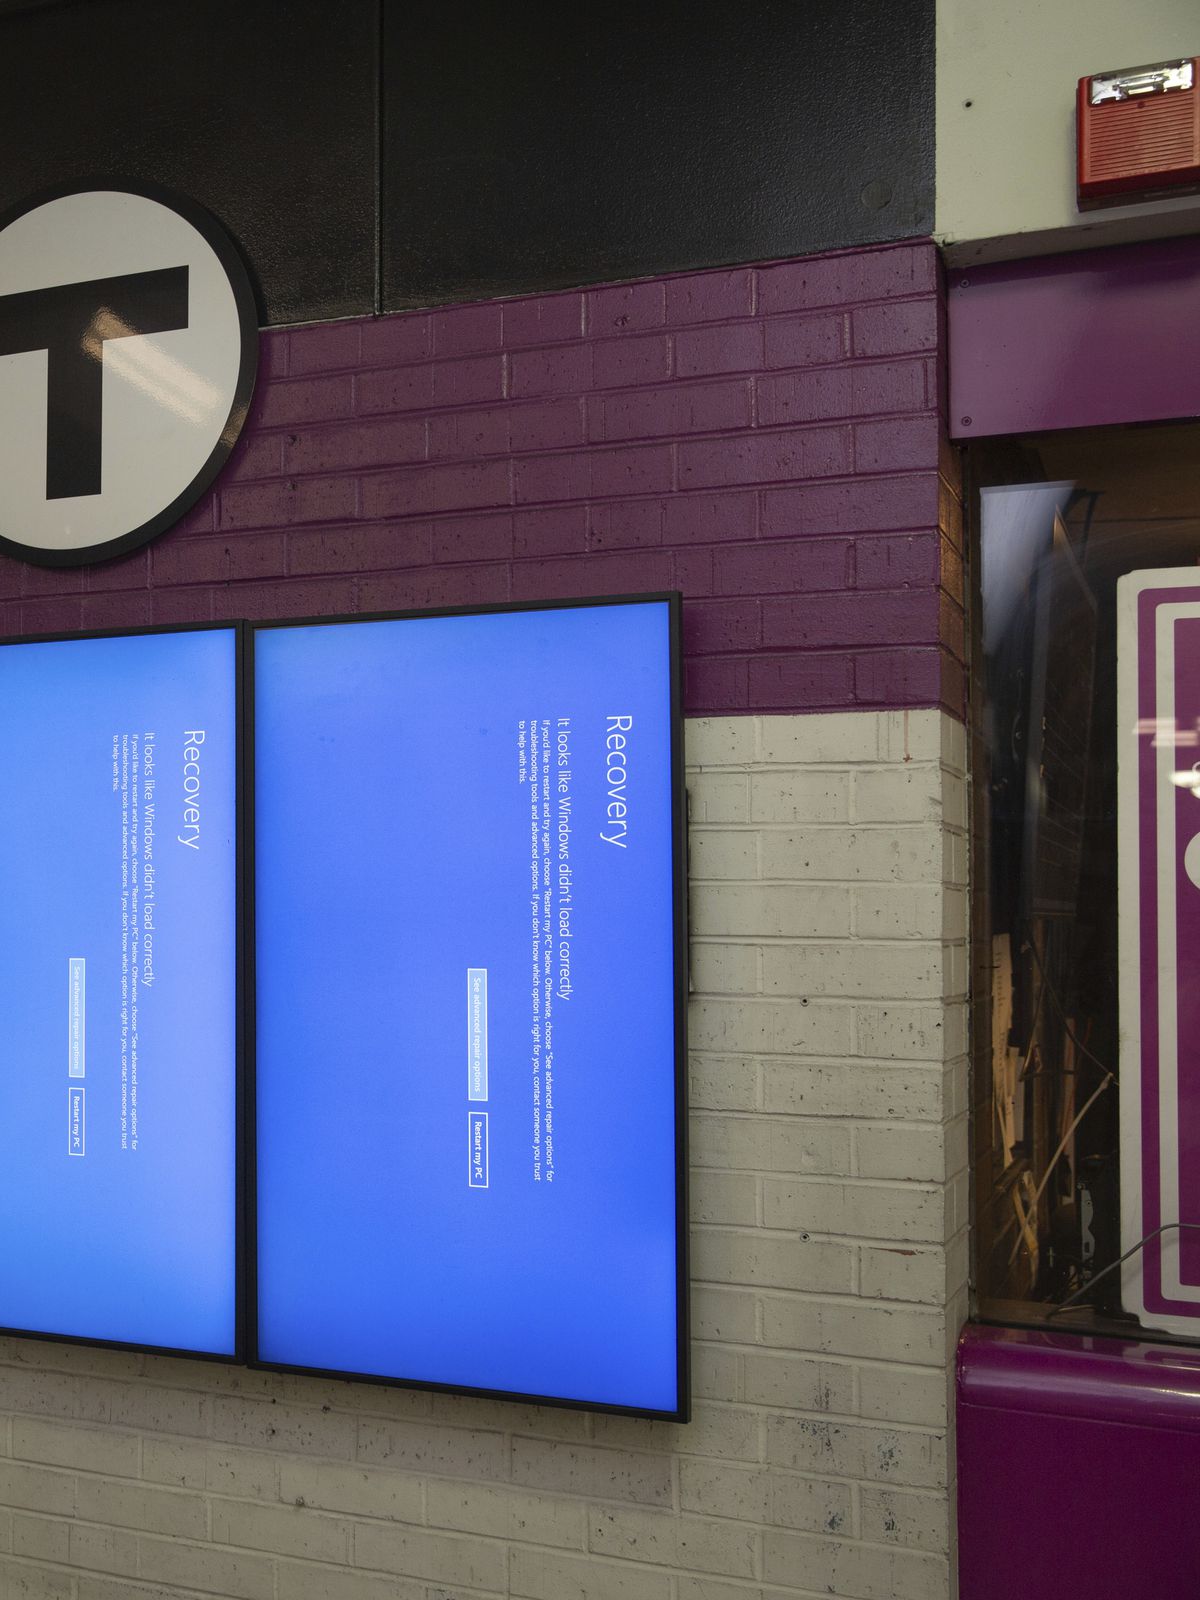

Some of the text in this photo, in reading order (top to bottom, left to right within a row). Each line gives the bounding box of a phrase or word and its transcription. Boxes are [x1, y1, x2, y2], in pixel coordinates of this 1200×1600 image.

[113, 735, 119, 743] to
[541, 727, 551, 748] you'd
[130, 740, 139, 760] you'd
[517, 721, 527, 784] to help with this.
[529, 720, 539, 782] troubleshooting
[542, 750, 551, 763] like
[120, 735, 129, 790] troubleshooting
[131, 761, 139, 773] like
[542, 765, 551, 774] to
[131, 775, 139, 783] to
[542, 775, 551, 801] restart
[600, 715, 632, 848] Recovery
[121, 791, 129, 809] tools
[131, 784, 139, 807] restart
[178, 730, 205, 850] Recovery
[530, 783, 539, 803] tools
[121, 810, 129, 824] and
[131, 809, 139, 822] and
[530, 804, 539, 819] and
[543, 802, 551, 817] and
[130, 823, 138, 834] try
[542, 819, 551, 830] try
[121, 825, 129, 859] advanced
[130, 835, 138, 857] again,
[531, 821, 540, 859] advanced
[542, 832, 552, 856] again,
[141, 733, 156, 987] It looks like Windows didn't load correctly
[556, 718, 573, 1000] It looks like Windows didn't load correctly
[120, 861, 129, 889] options.
[131, 858, 139, 884] choose
[530, 860, 540, 892] options.
[544, 857, 552, 886] choose
[131, 885, 139, 913] "Restart
[530, 901, 539, 916] you
[544, 888, 553, 918] "Restart
[121, 912, 129, 931] don't
[130, 914, 137, 926] my
[532, 918, 540, 939] don't
[543, 920, 551, 931] my
[121, 933, 129, 952] know
[131, 927, 139, 940] PC"
[544, 934, 553, 948] PC"
[131, 942, 139, 965] below.
[532, 940, 540, 961] know
[121, 953, 129, 974] which
[544, 950, 553, 976] below.
[131, 966, 139, 1004] Otherwise,
[532, 963, 541, 986] which
[120, 975, 129, 999] option
[531, 988, 541, 1014] option
[544, 977, 553, 1019] Otherwise,
[120, 1008, 128, 1025] right
[131, 1005, 139, 1031] choose
[131, 1033, 139, 1049] "See
[531, 1023, 541, 1043] right
[545, 1021, 554, 1050] choose
[473, 1035, 481, 1059] repair
[533, 1044, 541, 1056] for
[131, 1050, 139, 1084] advanced
[532, 1057, 540, 1074] you,
[545, 1052, 554, 1069] "See
[473, 1061, 482, 1092] options
[130, 1086, 138, 1107] repair
[533, 1076, 541, 1106] contact
[545, 1071, 554, 1109] advanced
[72, 1124, 79, 1136] my
[130, 1108, 138, 1138] options"
[544, 1110, 554, 1134] repair
[74, 1137, 81, 1147] PC
[131, 1140, 139, 1150] for
[473, 1121, 482, 1179] Restart my PC
[532, 1145, 540, 1160] you
[544, 1135, 554, 1168] options"
[533, 1162, 541, 1181] trust
[546, 1170, 554, 1182] for
